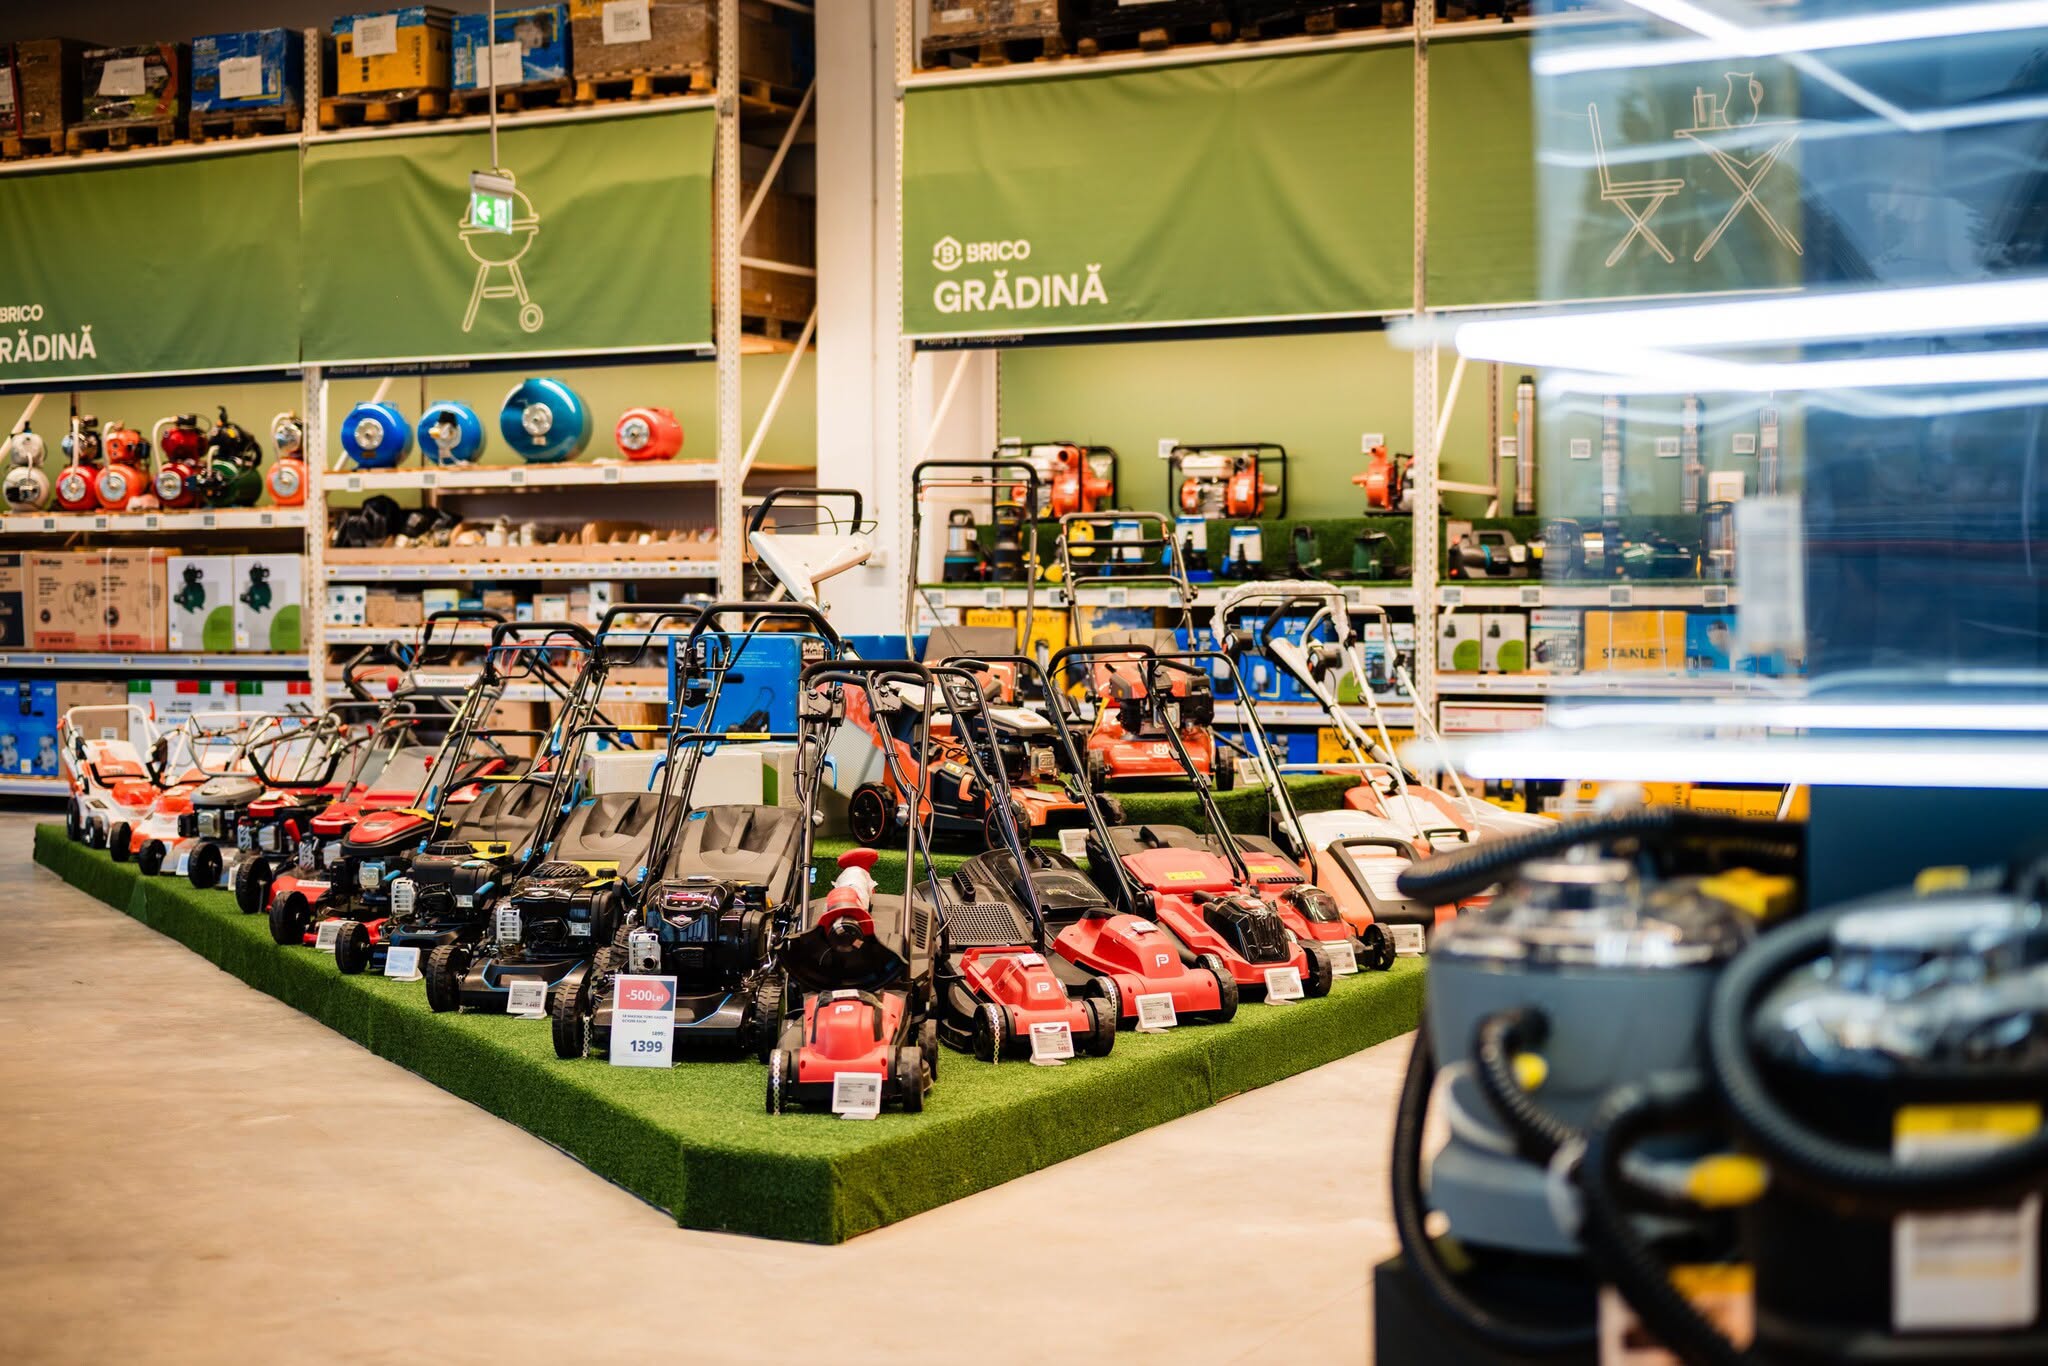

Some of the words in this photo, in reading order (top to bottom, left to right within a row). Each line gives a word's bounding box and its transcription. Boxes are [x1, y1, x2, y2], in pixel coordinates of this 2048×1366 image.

[966, 239, 1031, 263] BRICO
[933, 263, 1109, 313] GRĂDINĂ
[0, 304, 43, 323] BRICO
[1601, 647, 1668, 659] STANLEY
[630, 1039, 663, 1053] 1399
